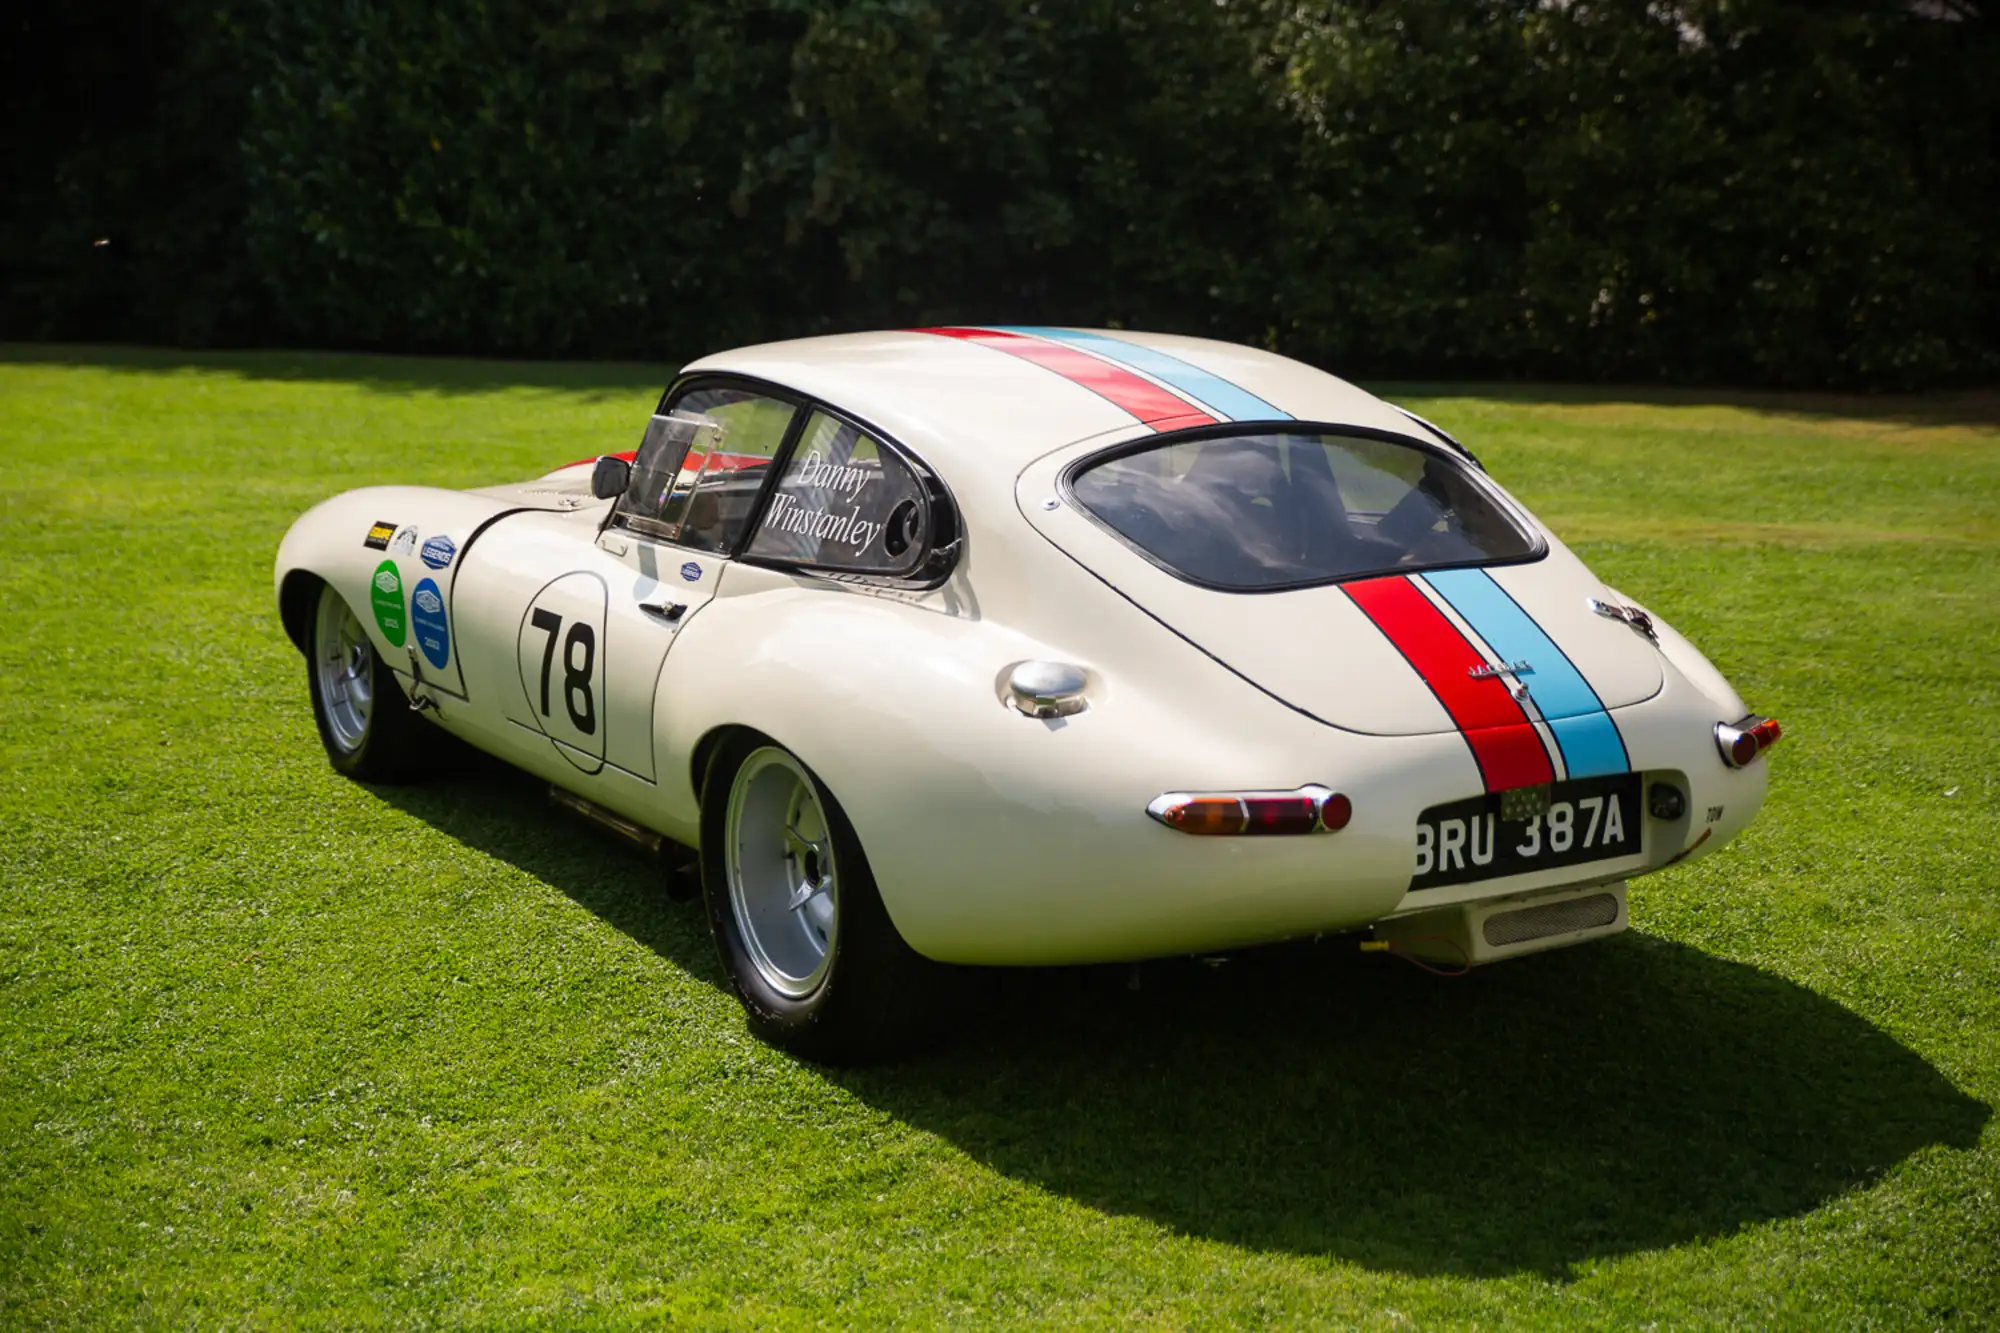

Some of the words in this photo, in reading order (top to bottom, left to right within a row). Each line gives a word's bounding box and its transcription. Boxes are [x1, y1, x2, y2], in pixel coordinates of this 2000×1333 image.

[796, 450, 871, 504] Danny
[764, 492, 882, 557] Winstanley
[530, 606, 596, 736] 78
[1413, 812, 1495, 876] BRU
[1515, 793, 1625, 858] 387A
